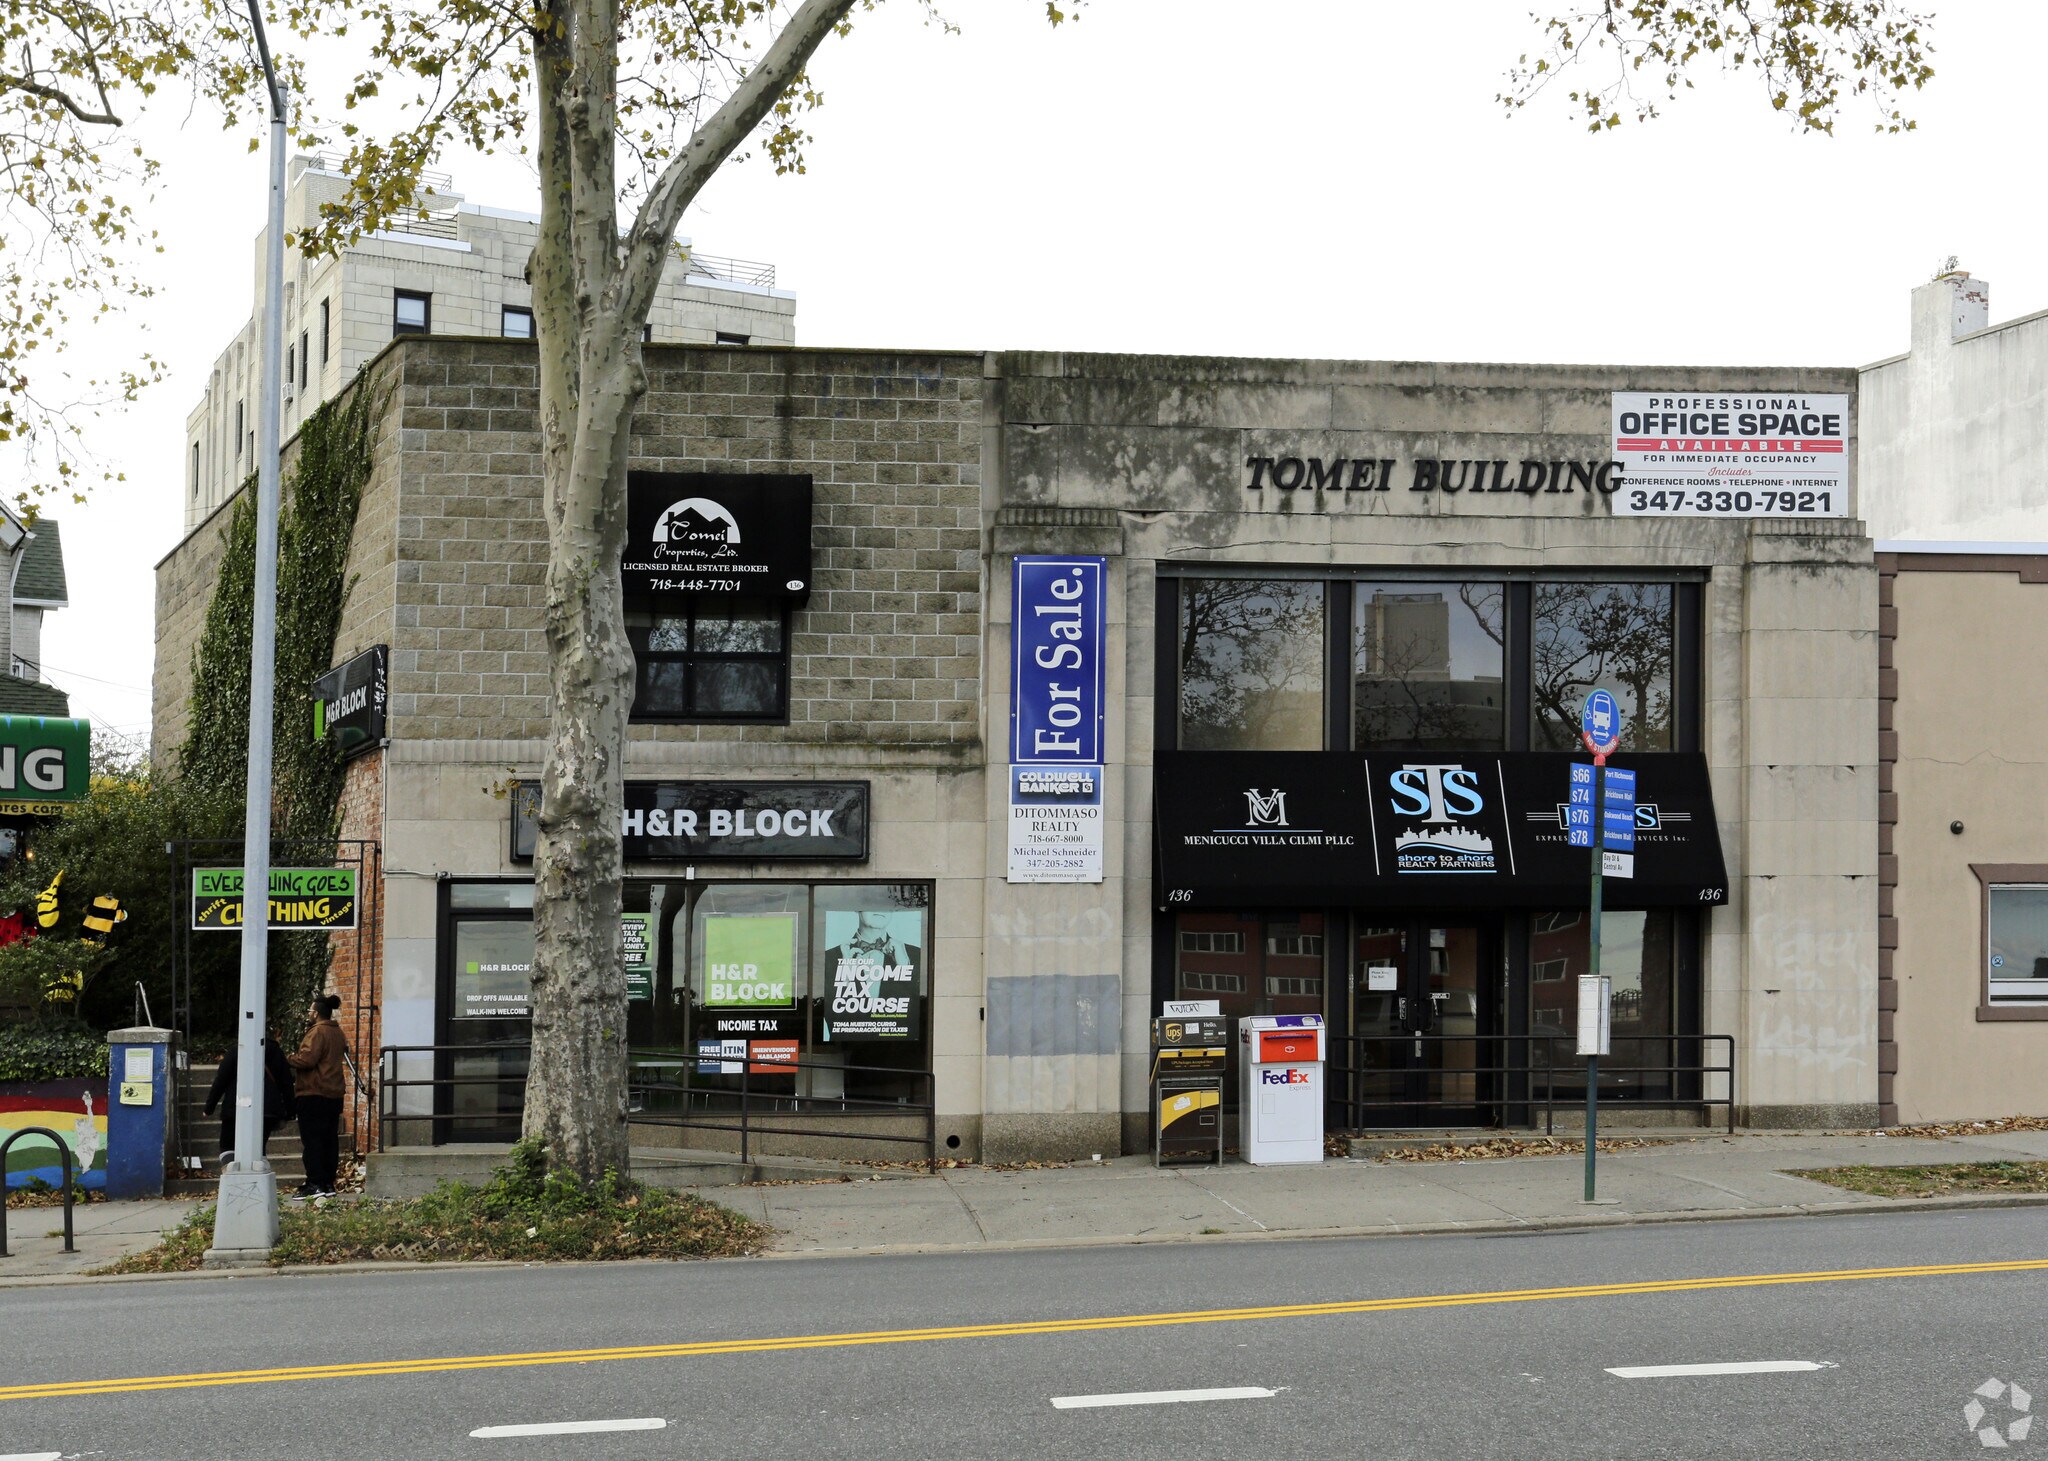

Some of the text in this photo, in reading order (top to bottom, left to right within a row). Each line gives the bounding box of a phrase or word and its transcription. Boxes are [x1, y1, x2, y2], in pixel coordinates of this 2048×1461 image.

[1649, 398, 1810, 410] PROFESSIONAL
[1619, 412, 1841, 436] OFFICE SPACE
[1659, 440, 1802, 451] AVAILABLE
[1643, 454, 1817, 463] FOR IMMEDIATE OCCUPANCY
[1246, 457, 1626, 494] TOMEI BUILDING
[1707, 466, 1753, 476] Includes
[1622, 477, 1838, 487] CONFERENCE ROOMS TELEPHONE INTERNET
[1630, 490, 1831, 512] 347-330-7921
[670, 520, 725, 541] Tomei
[654, 543, 739, 562] Properties, Ltd.
[623, 562, 769, 573] LICENSED REAL ESTATE BROKER
[650, 578, 741, 591] 718-448-7701
[1034, 567, 1084, 755] For Sale.
[326, 685, 367, 724] H&R BLOCK
[1586, 734, 1594, 746] NO
[1389, 764, 1484, 823] STS
[1014, 808, 1098, 819] DITOMMASO
[623, 809, 835, 837] H&R BLOCK
[1032, 821, 1080, 832] REALTY
[1028, 834, 1084, 843] 718-667-8000
[1184, 836, 1354, 845] MENICUCCI VILLA CILMI PLLC
[1014, 847, 1097, 856] Michael Schneider
[1027, 859, 1084, 868] 347-205-2882
[1398, 854, 1436, 862] shore
[1457, 854, 1495, 862] shore
[201, 872, 350, 896] EVERHING GOES
[1168, 889, 1194, 901] 136
[1698, 888, 1723, 900] 136
[198, 897, 353, 925] thrift CLTHING vintage
[625, 953, 643, 961] REE.
[711, 963, 758, 981] H&R
[834, 964, 914, 982] INCOME
[711, 983, 785, 1000] BLOCK
[834, 981, 874, 998] TAX
[832, 997, 910, 1013] COURSE
[718, 1020, 778, 1031] INCOME TAX
[1167, 1029, 1181, 1040] ups
[724, 1046, 744, 1054] ITIN
[1262, 1069, 1309, 1085] FedEx
